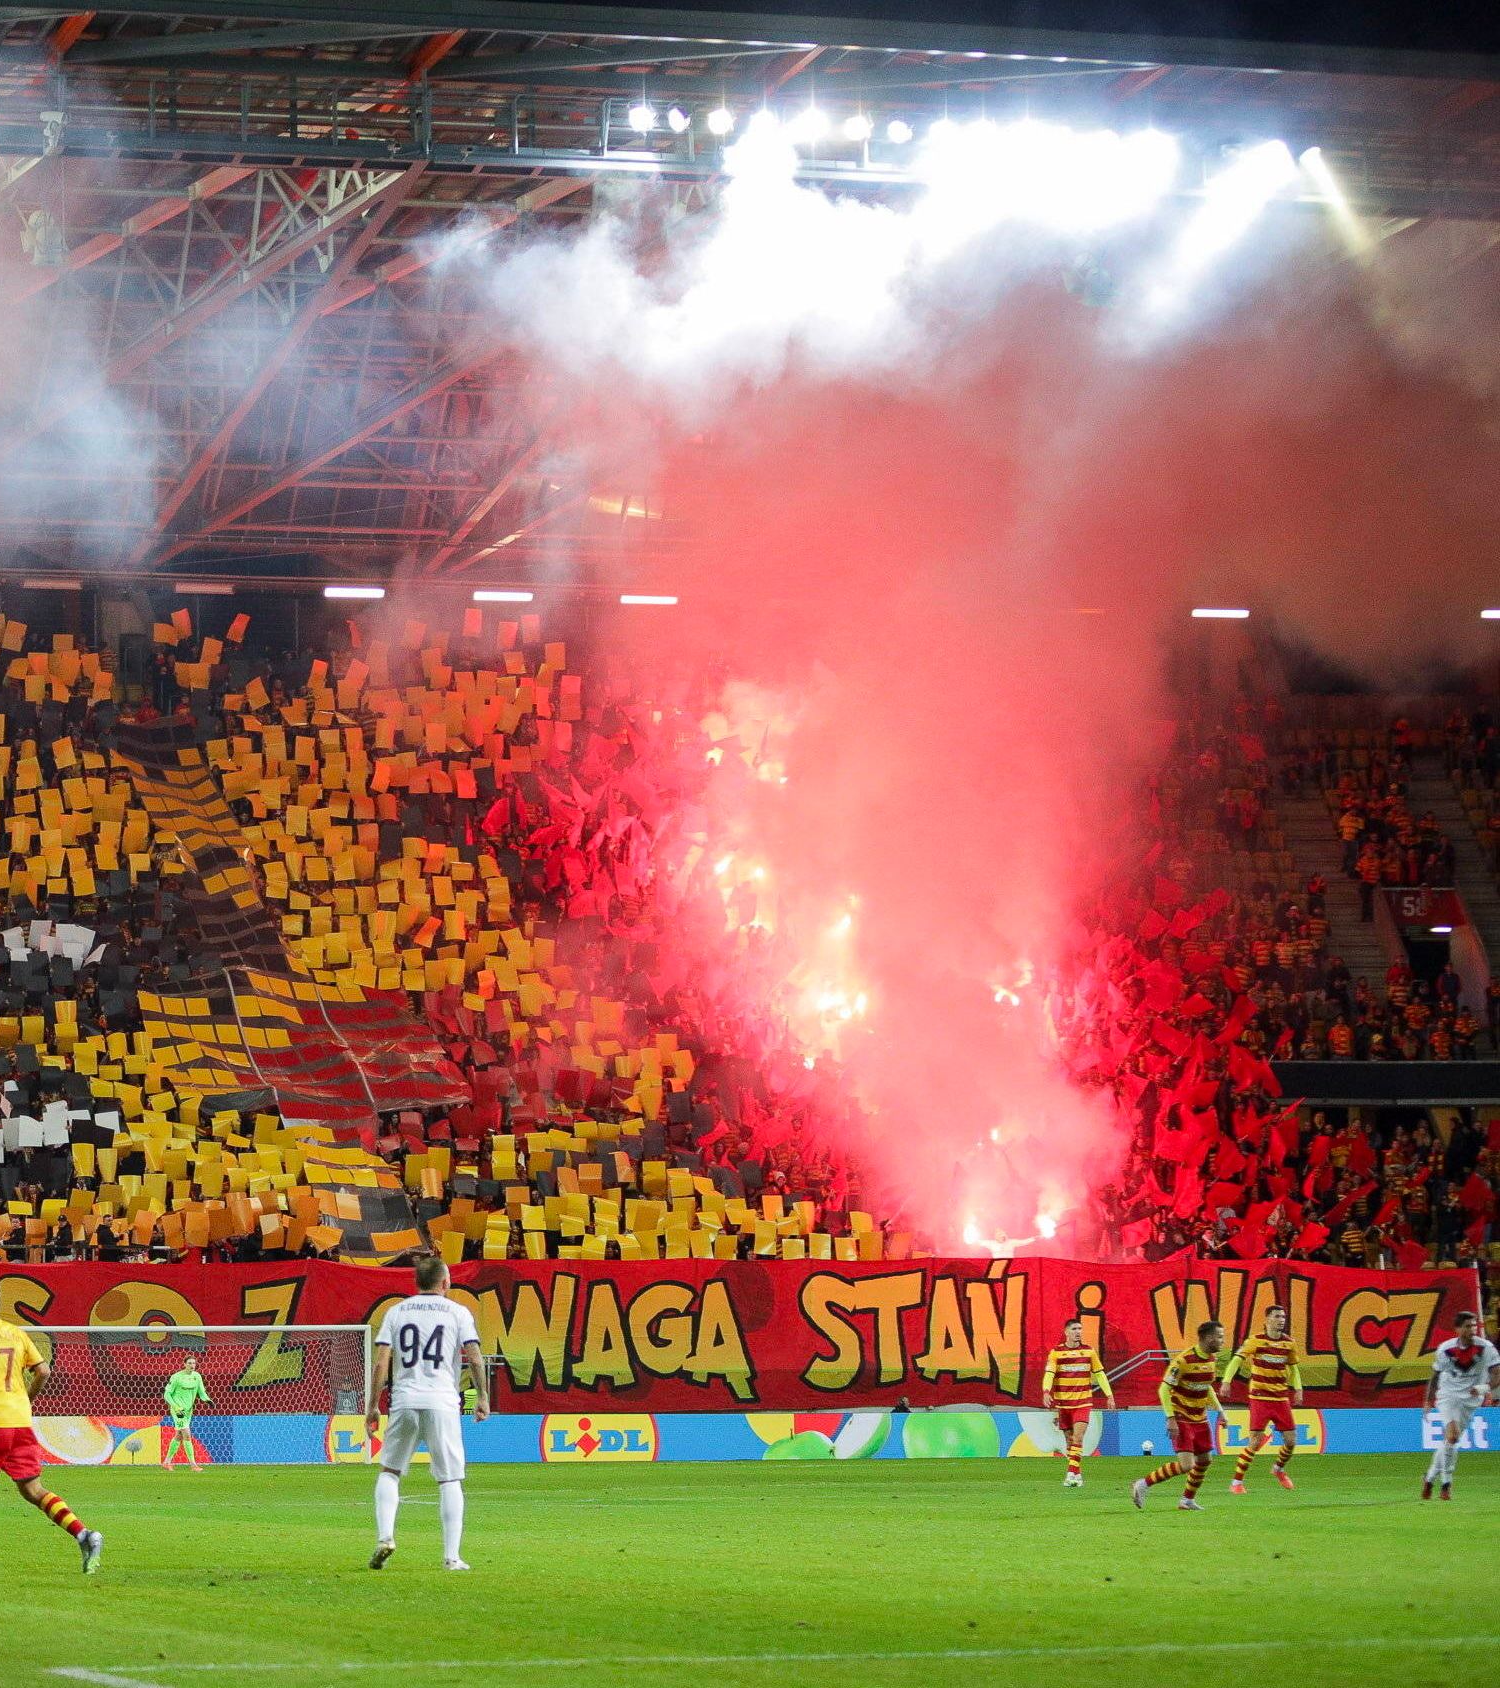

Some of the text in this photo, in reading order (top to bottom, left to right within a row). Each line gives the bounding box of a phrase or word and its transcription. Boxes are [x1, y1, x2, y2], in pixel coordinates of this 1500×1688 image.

[230, 1275, 307, 1393] Z
[798, 1258, 1029, 1400] STAŃ
[1151, 1266, 1448, 1392] WALCZ
[400, 1323, 445, 1370] 94
